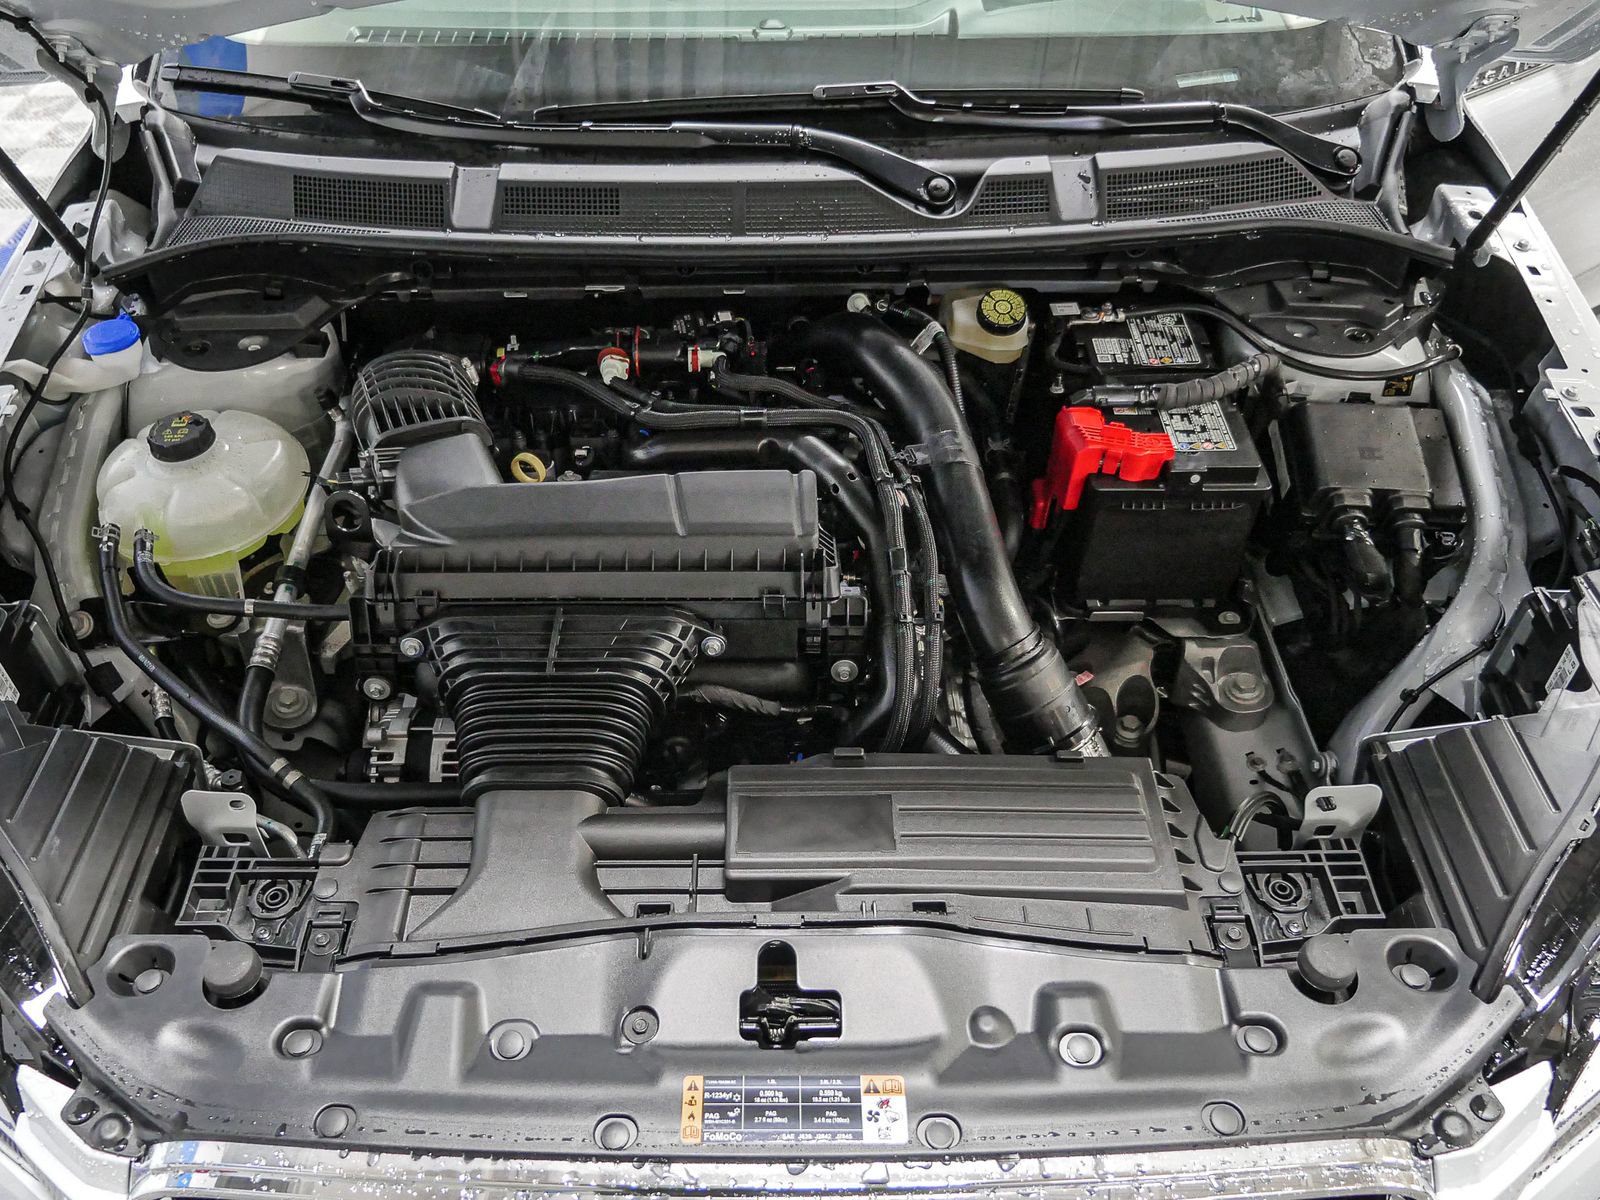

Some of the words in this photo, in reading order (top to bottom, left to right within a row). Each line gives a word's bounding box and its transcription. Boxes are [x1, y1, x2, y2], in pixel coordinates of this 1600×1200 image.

[704, 1091, 732, 1100] R-1234yf
[775, 1090, 783, 1098] kg
[835, 1090, 842, 1098] kg
[703, 1132, 743, 1140] FoMoCo
